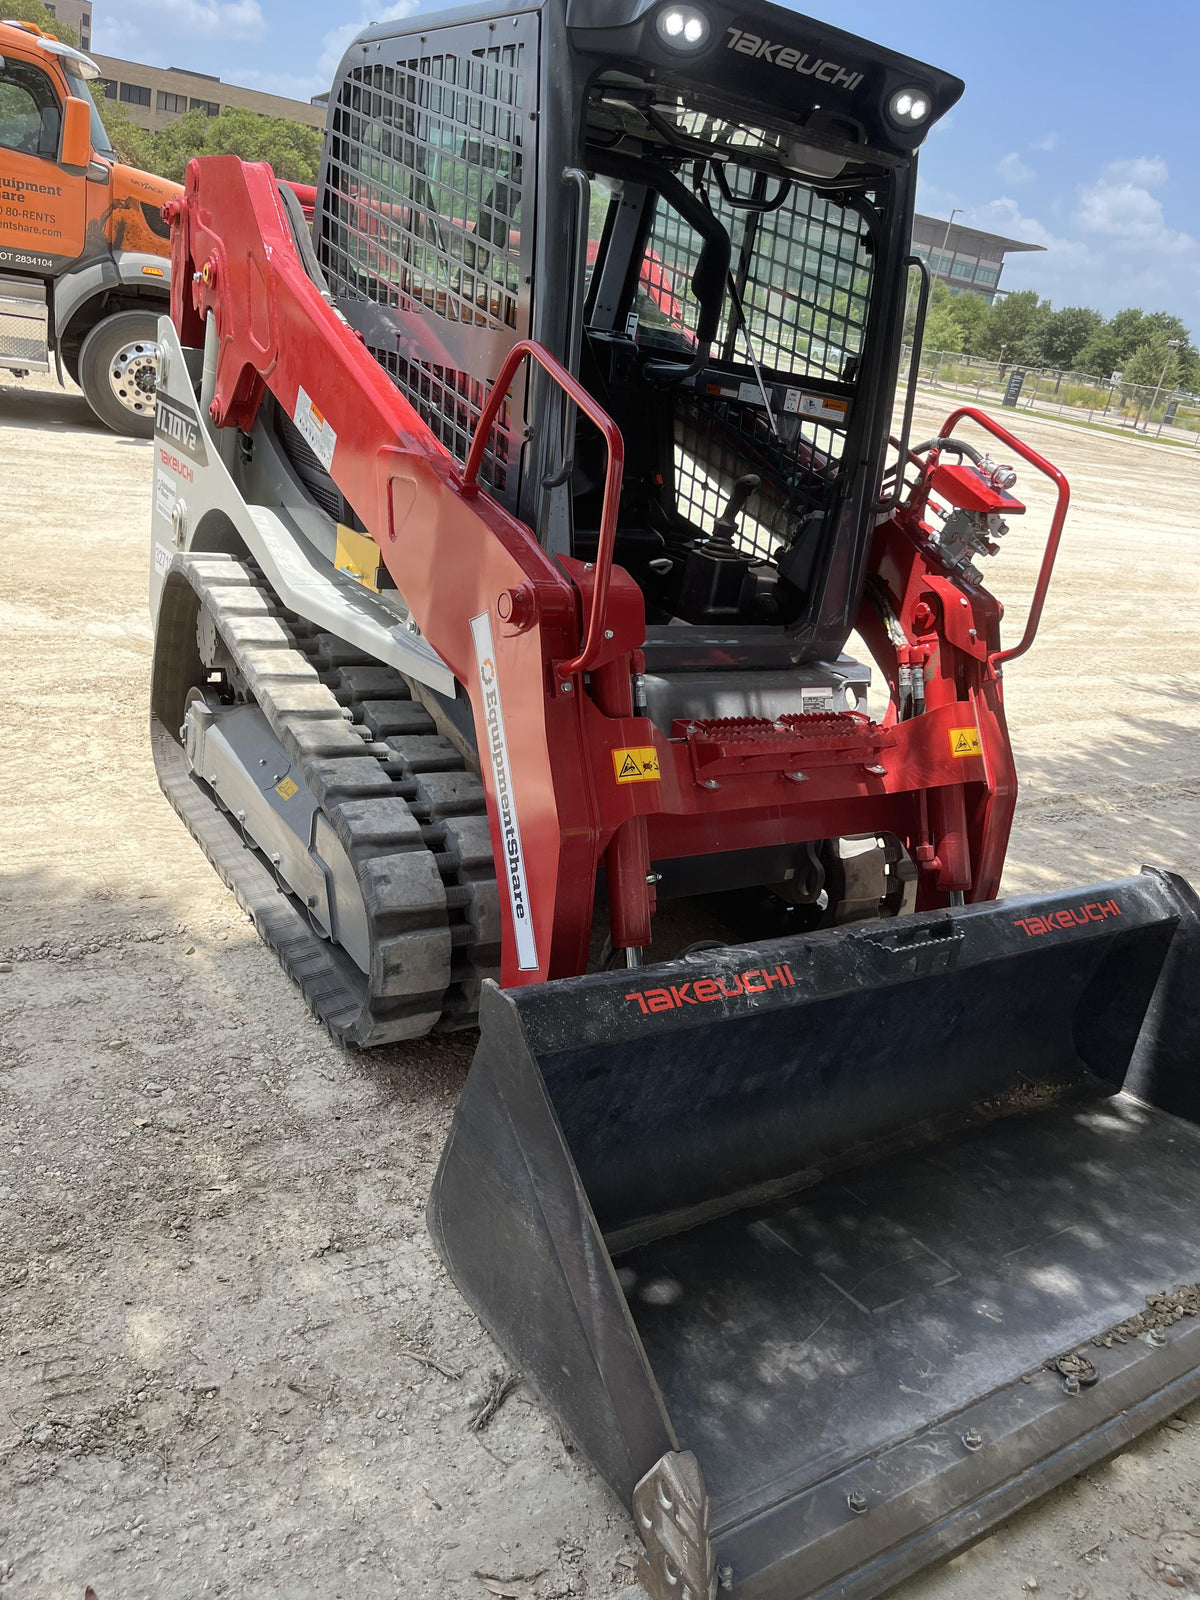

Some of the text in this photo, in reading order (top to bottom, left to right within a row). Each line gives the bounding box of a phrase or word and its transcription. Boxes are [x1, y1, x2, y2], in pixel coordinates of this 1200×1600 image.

[0, 177, 62, 197] uipment
[0, 190, 25, 203] are
[5, 206, 56, 224] 80-RENTS
[15, 254, 53, 268] 2834104
[485, 689, 526, 920] EquipmentShare
